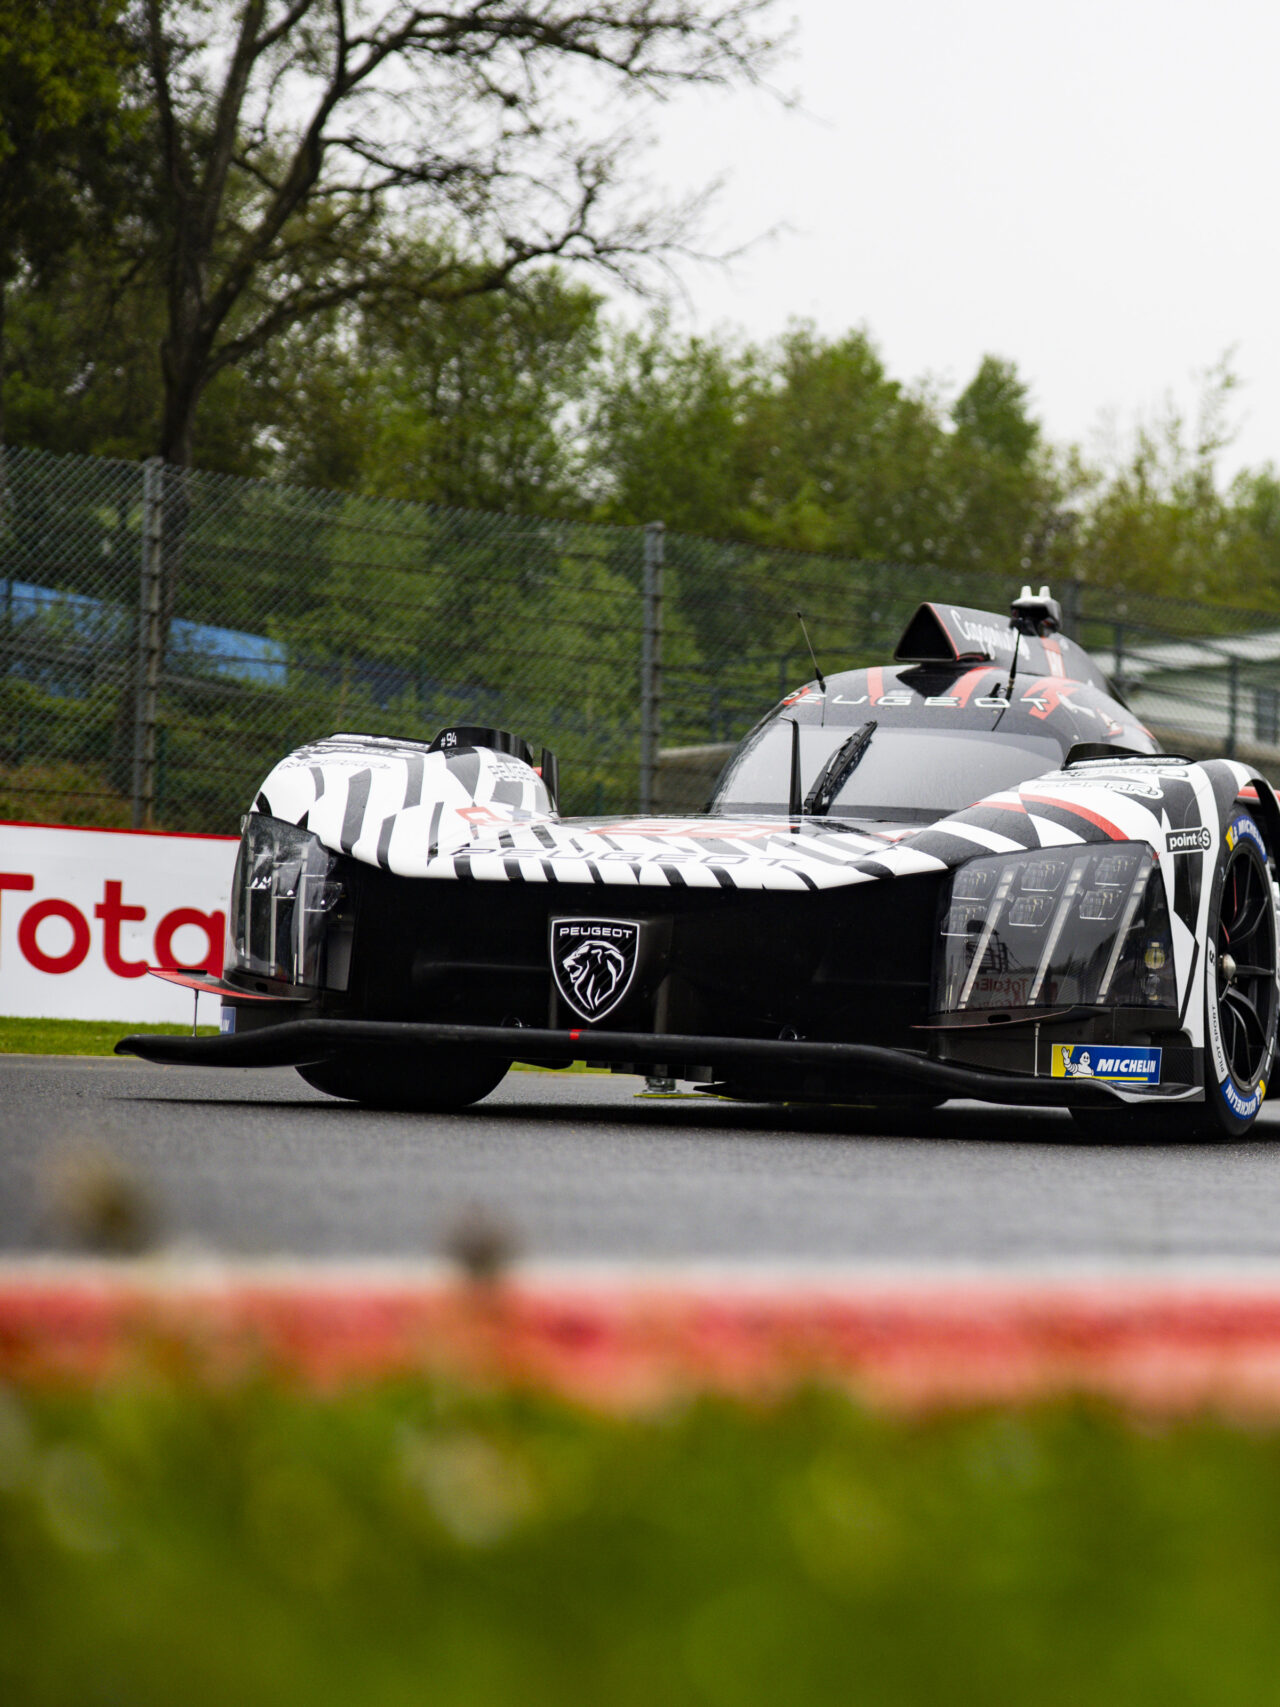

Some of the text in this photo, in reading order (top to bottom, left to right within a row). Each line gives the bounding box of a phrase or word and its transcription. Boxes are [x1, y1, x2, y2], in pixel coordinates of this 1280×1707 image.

[784, 691, 1048, 712] PEUGEOT
[441, 731, 457, 748] #94
[450, 848, 802, 868] PEUGEOT
[559, 926, 633, 939] PEUGEOT
[1096, 1058, 1156, 1074] MICHELIN
[1224, 1083, 1257, 1117] MICHELIN
